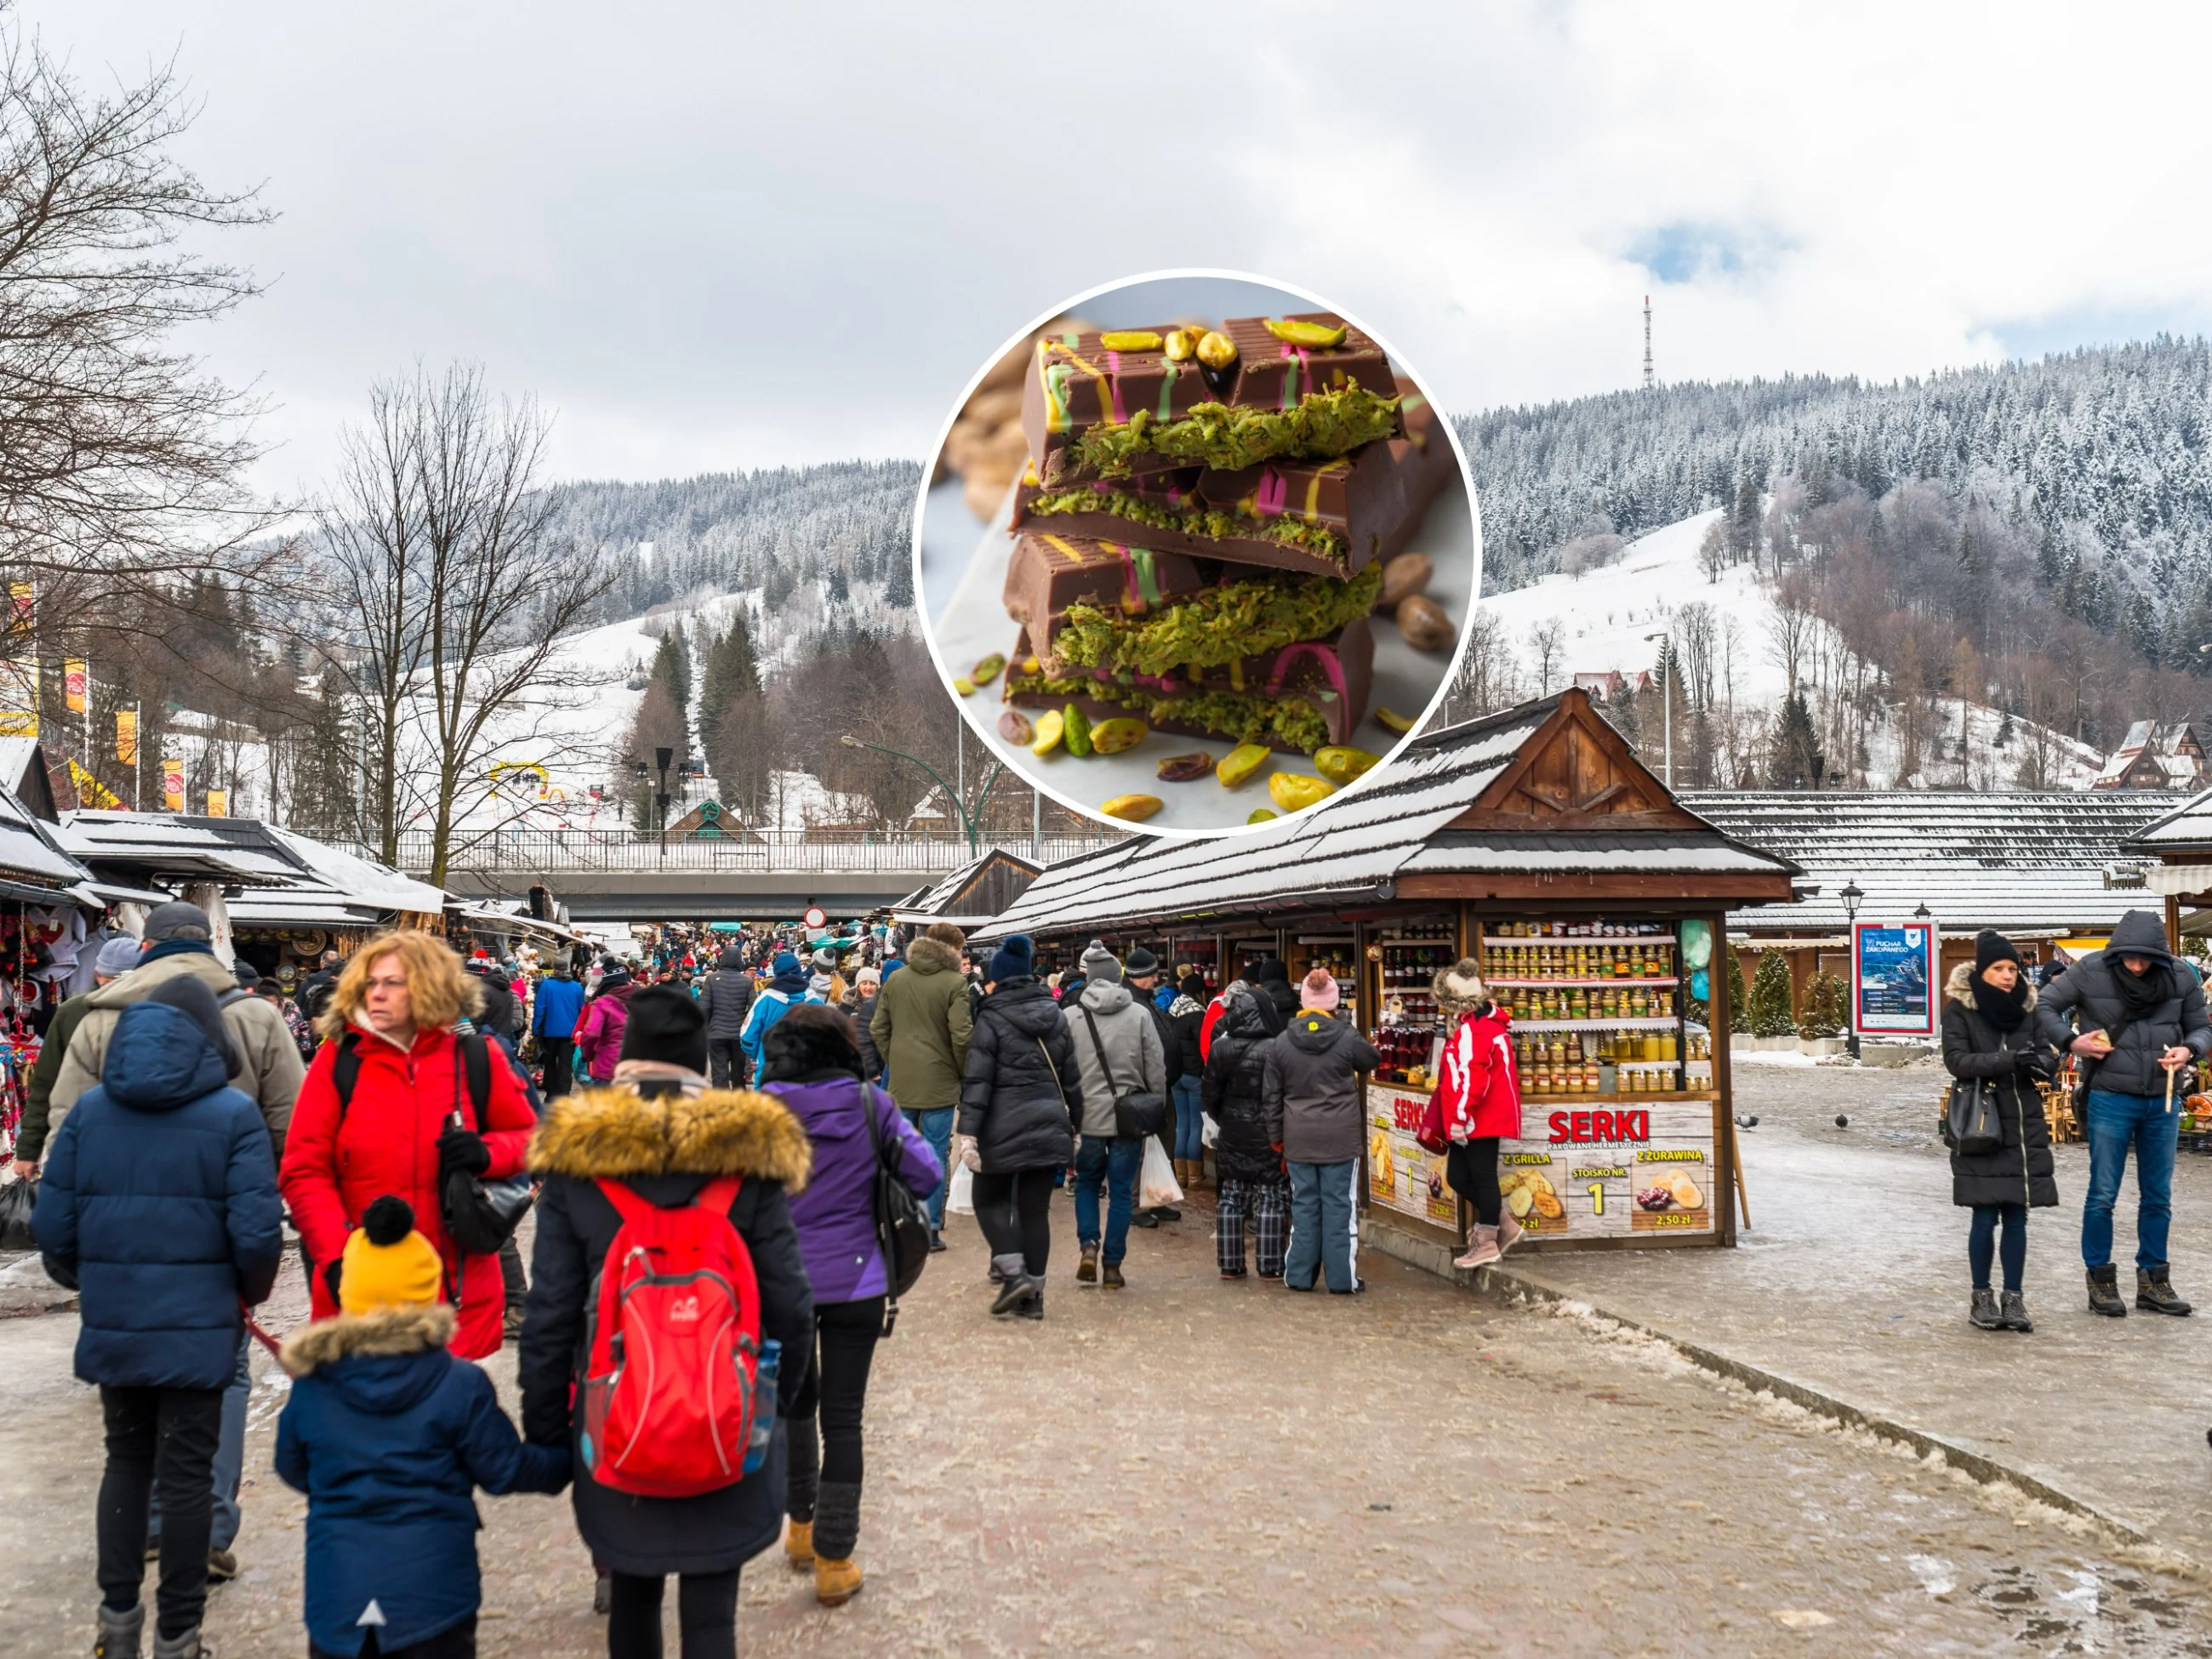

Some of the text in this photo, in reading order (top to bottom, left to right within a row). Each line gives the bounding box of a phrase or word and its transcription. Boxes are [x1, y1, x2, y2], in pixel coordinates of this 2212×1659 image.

[1394, 1097, 1425, 1132] SERK
[1548, 1109, 1650, 1143] SERKI
[1547, 1141, 1651, 1151] PAKOWANE HERMETYCZNIE
[1503, 1154, 1552, 1165] Z GRILLA
[1637, 1149, 1703, 1163] Z ŻURAWINĄ
[1572, 1168, 1628, 1178] STOISKO NR.
[1406, 1166, 1412, 1197] 1
[1588, 1182, 1603, 1215] 1
[1519, 1217, 1539, 1229] 2 zł
[1656, 1214, 1691, 1226] 2,50 zł
